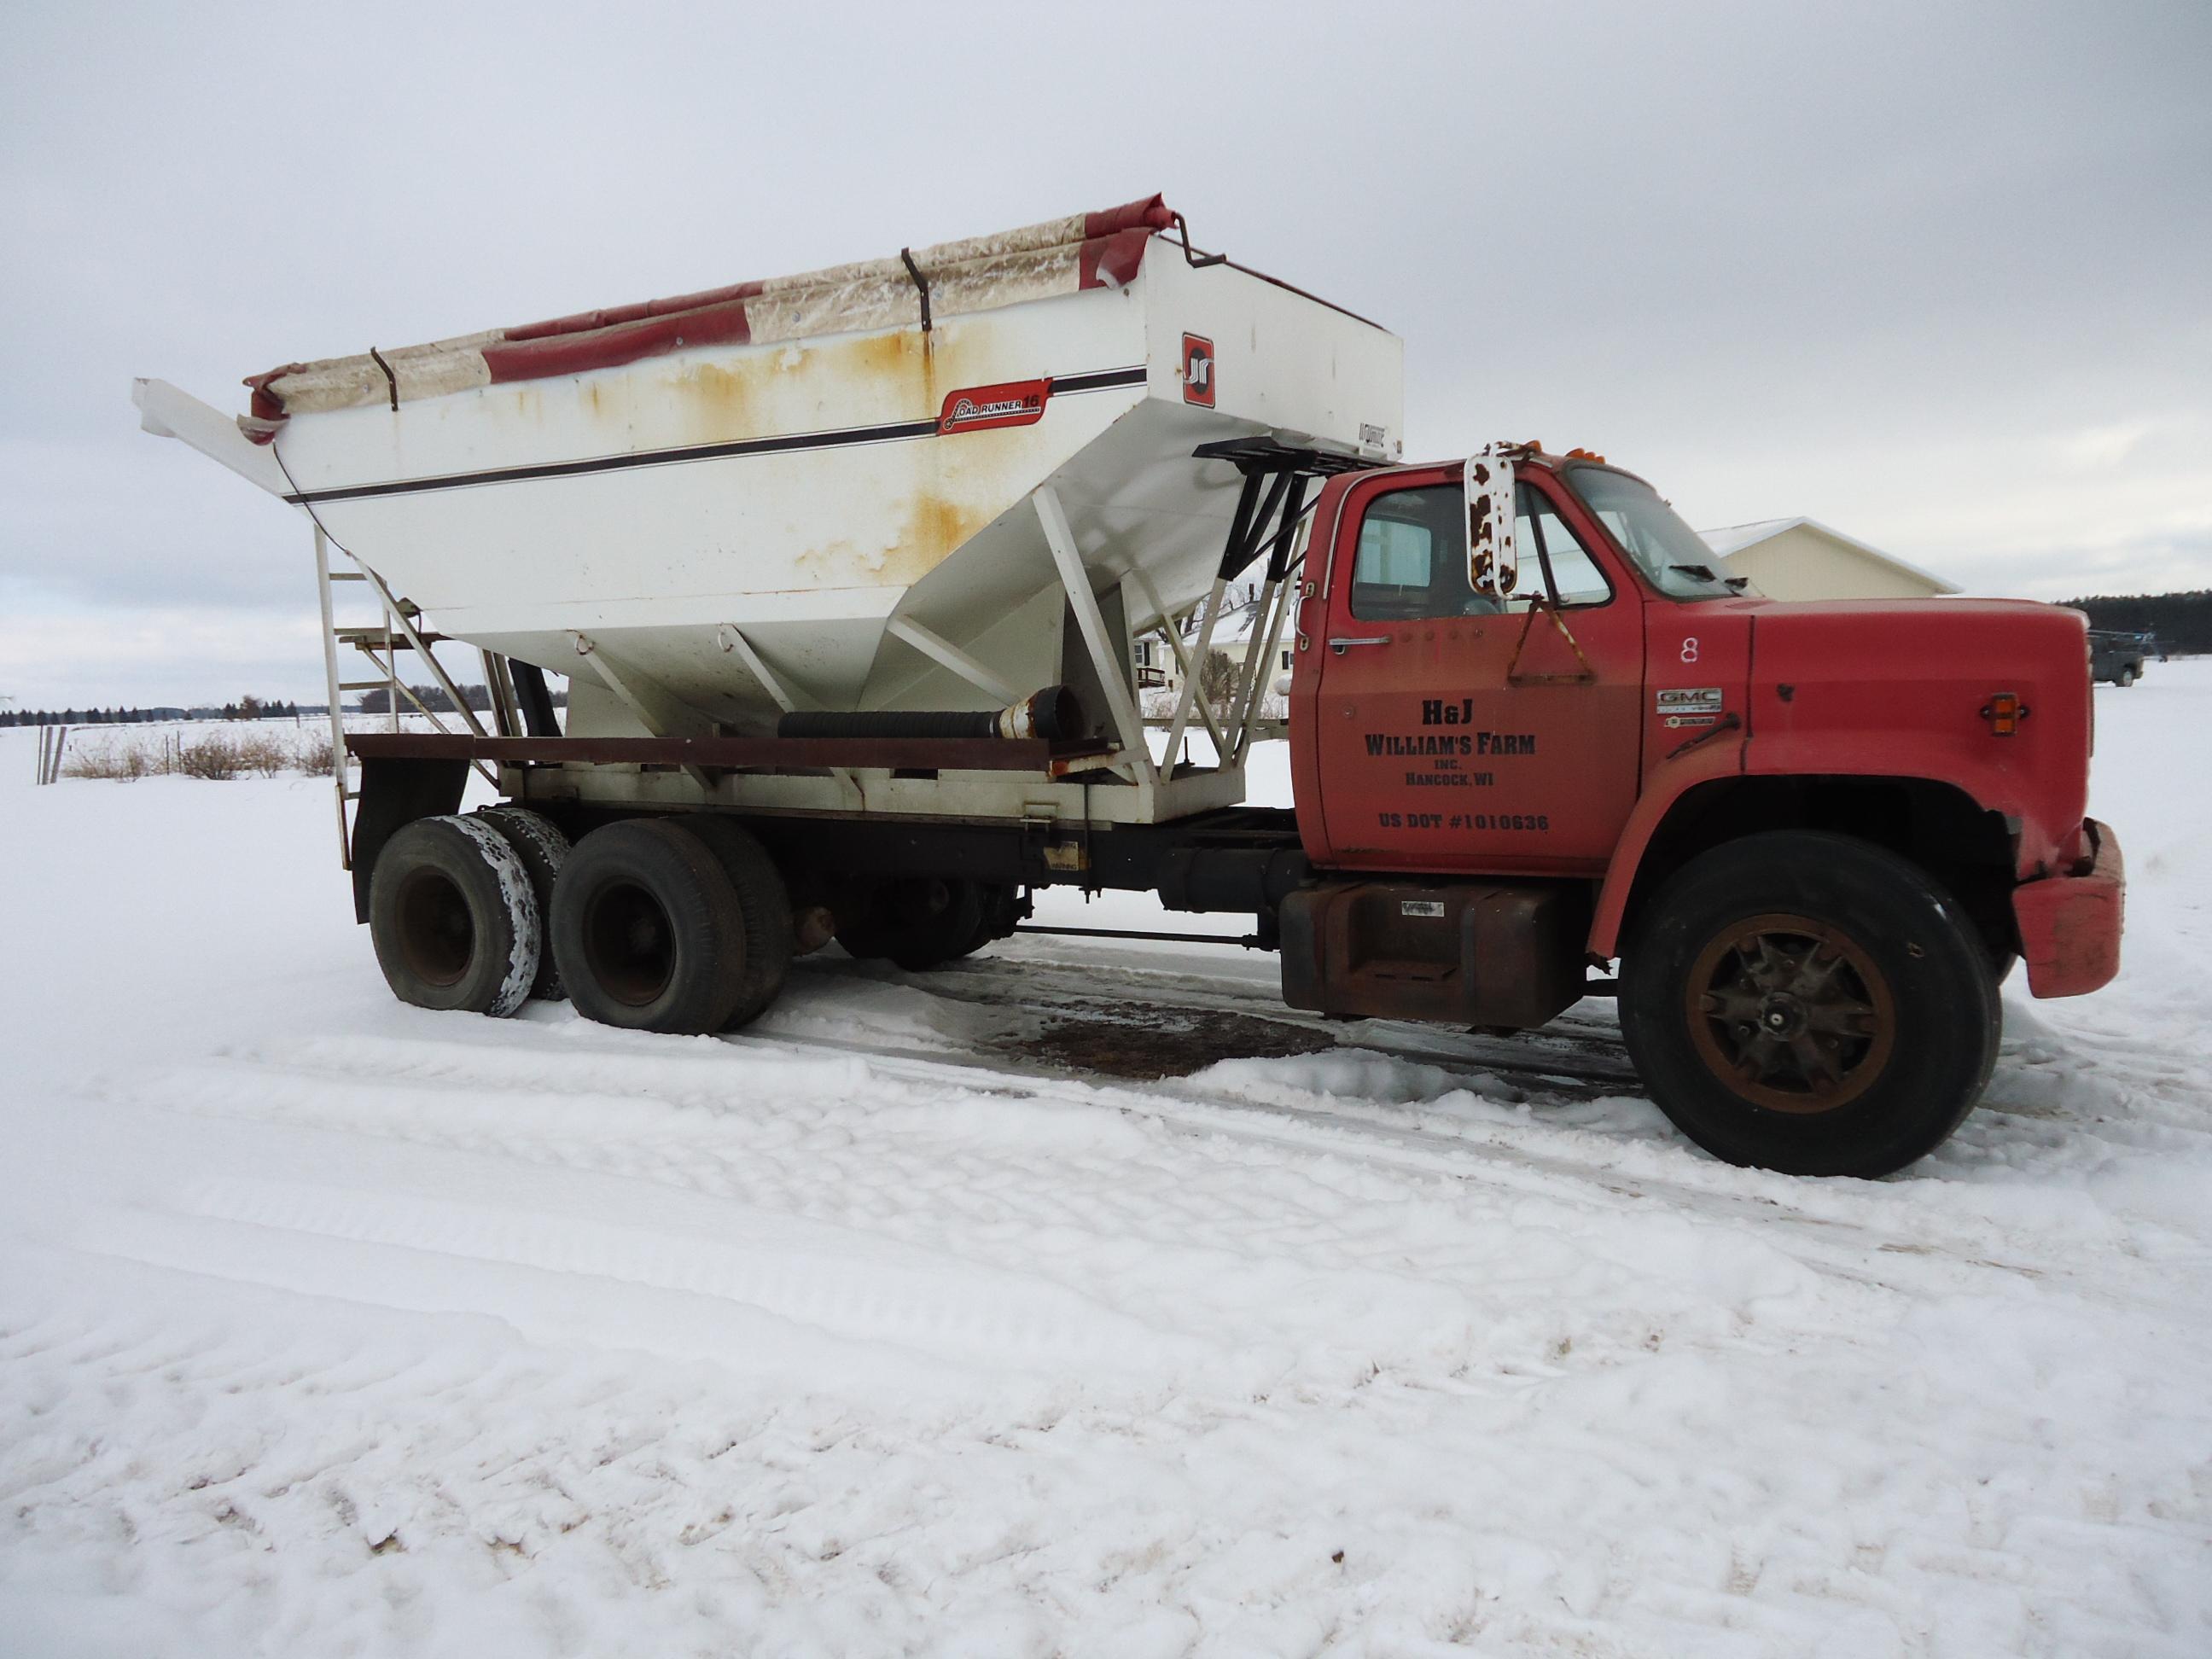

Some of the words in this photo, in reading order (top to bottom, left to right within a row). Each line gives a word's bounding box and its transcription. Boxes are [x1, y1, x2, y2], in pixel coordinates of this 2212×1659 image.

[981, 401, 1022, 414] RUNNER
[1024, 395, 1039, 408] 16
[1681, 637, 1698, 663] 8
[1660, 691, 1719, 702] GMC
[1422, 698, 1473, 725] H&J
[1365, 734, 1471, 756] WILLIAM'S
[1476, 731, 1535, 755] FARM
[1435, 759, 1462, 770] INC.
[1473, 772, 1495, 786] WI
[1379, 813, 1401, 828] US
[1407, 813, 1442, 828] DOT
[1449, 815, 1549, 831] #1010636
